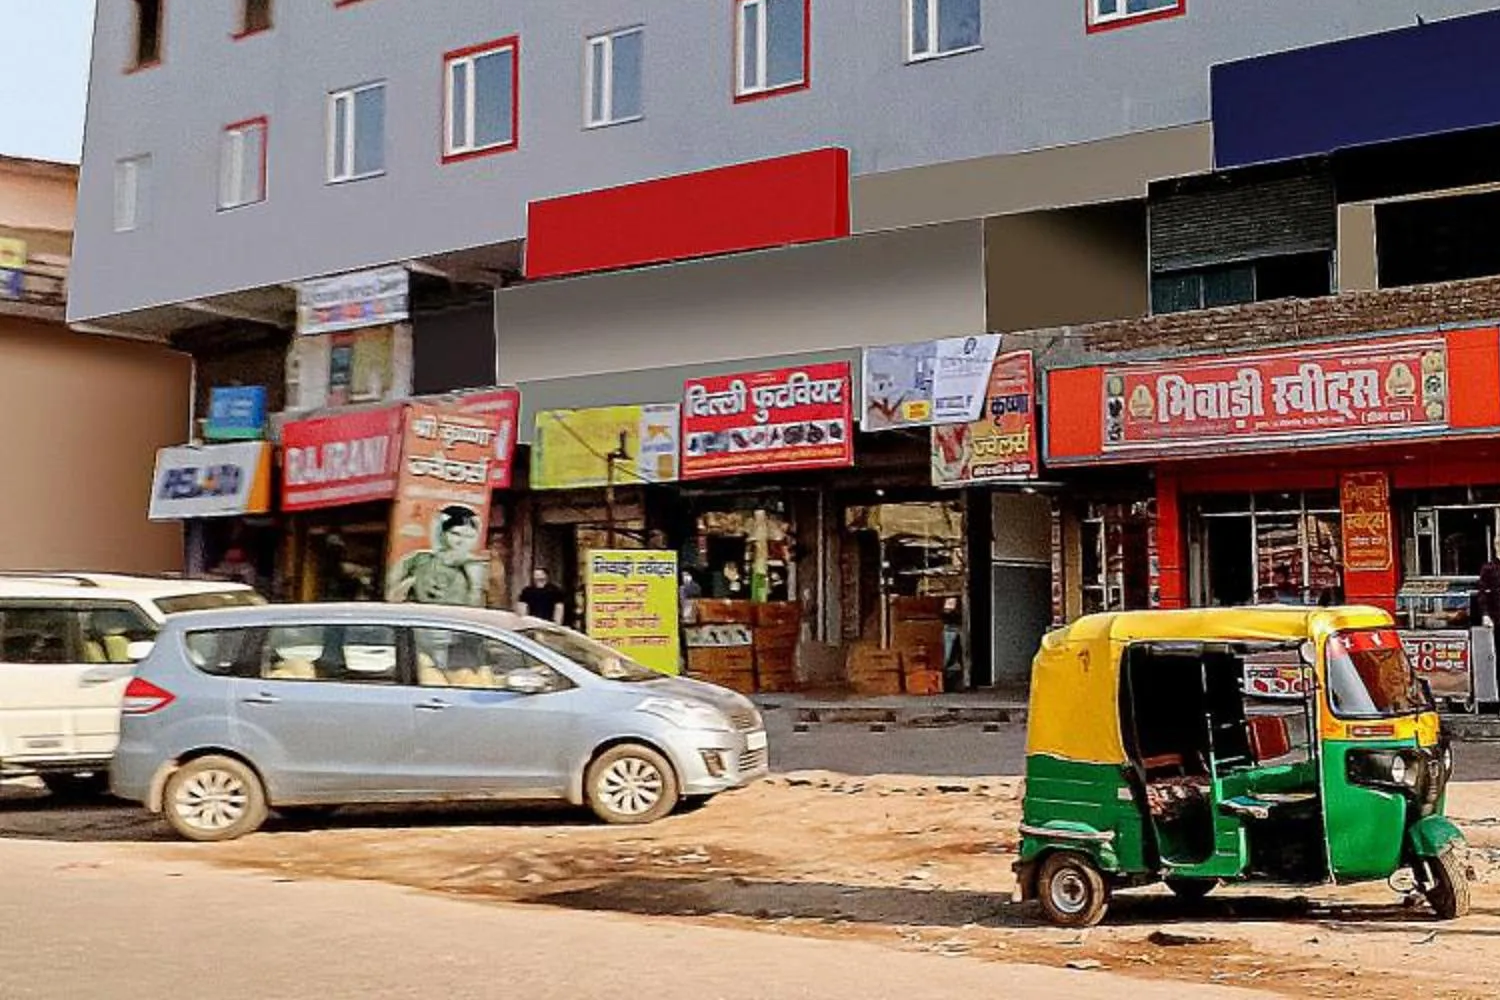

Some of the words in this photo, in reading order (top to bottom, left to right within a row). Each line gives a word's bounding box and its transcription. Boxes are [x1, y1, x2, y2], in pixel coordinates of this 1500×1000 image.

[687, 379, 748, 418] दिल्ली
[751, 372, 843, 423] फुटवियर
[1270, 363, 1379, 420] स्वीट्स
